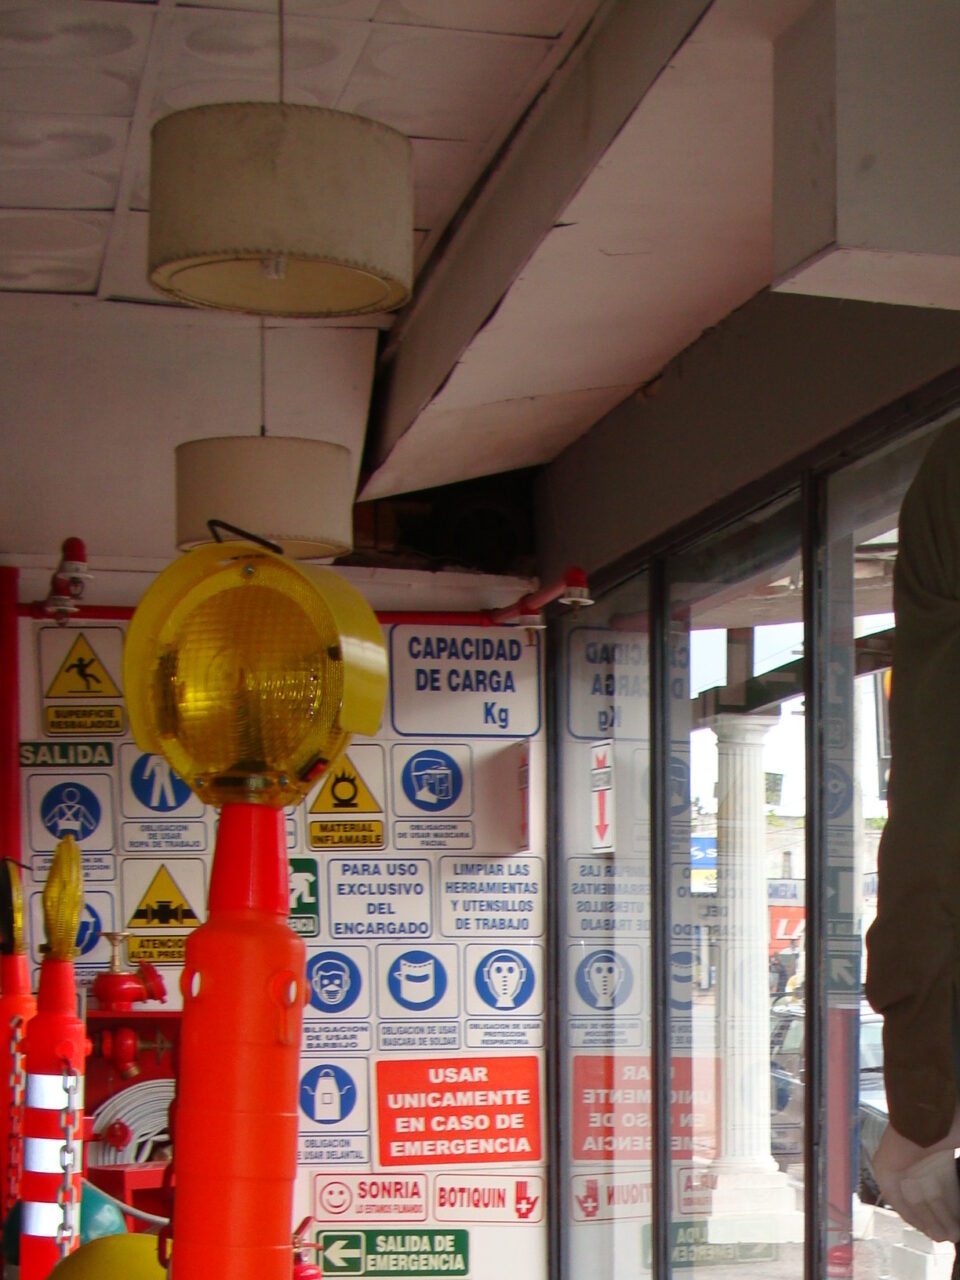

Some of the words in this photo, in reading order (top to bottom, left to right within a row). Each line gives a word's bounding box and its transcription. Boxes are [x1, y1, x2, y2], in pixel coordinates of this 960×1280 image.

[409, 636, 522, 661] CAPACIDAD
[416, 668, 442, 691] DE
[448, 669, 515, 693] CARGA
[54, 709, 115, 719] SUPERFICIE
[484, 701, 509, 729] Kg
[50, 720, 120, 729] RESBALADIZA
[21, 745, 110, 764] SALIDA
[319, 823, 374, 833] MATERIAL
[312, 834, 383, 845] INFLAMABLE
[341, 863, 381, 876] PARA
[387, 863, 418, 876] USO
[453, 863, 504, 876] LIMPIAR
[508, 864, 530, 876] LAS
[337, 882, 424, 895] EXCLUSIVO
[445, 882, 538, 895] HERRAMIENTAS
[367, 902, 396, 915] DEL
[451, 900, 458, 912] Y
[462, 900, 533, 912] UTENSILLOS
[334, 922, 429, 935] ENCARGADO
[455, 918, 473, 931] DE
[475, 918, 530, 931] TRABAJO
[138, 939, 184, 949] ATENCIO
[130, 950, 154, 959] ALTA
[157, 950, 184, 959] PRES
[428, 1026, 437, 1035] DE
[439, 1026, 457, 1034] USAR
[430, 1037, 457, 1045] SOLDAR
[428, 1067, 488, 1084] USAR
[387, 1089, 531, 1109] UNICAMENTE
[395, 1117, 425, 1133] EN
[431, 1115, 490, 1131] CASO
[496, 1114, 524, 1130] DE
[304, 1139, 351, 1148] OBLIGACION
[390, 1138, 532, 1157] EMERGENCIA
[304, 1151, 323, 1160] USAR
[326, 1150, 364, 1160] DELANTAL
[357, 1181, 421, 1199] SONRIA
[438, 1187, 506, 1208] BOTIQUIN
[376, 1235, 431, 1252] SALIDA
[434, 1236, 455, 1252] DE
[366, 1254, 465, 1271] EMERGENCIA
